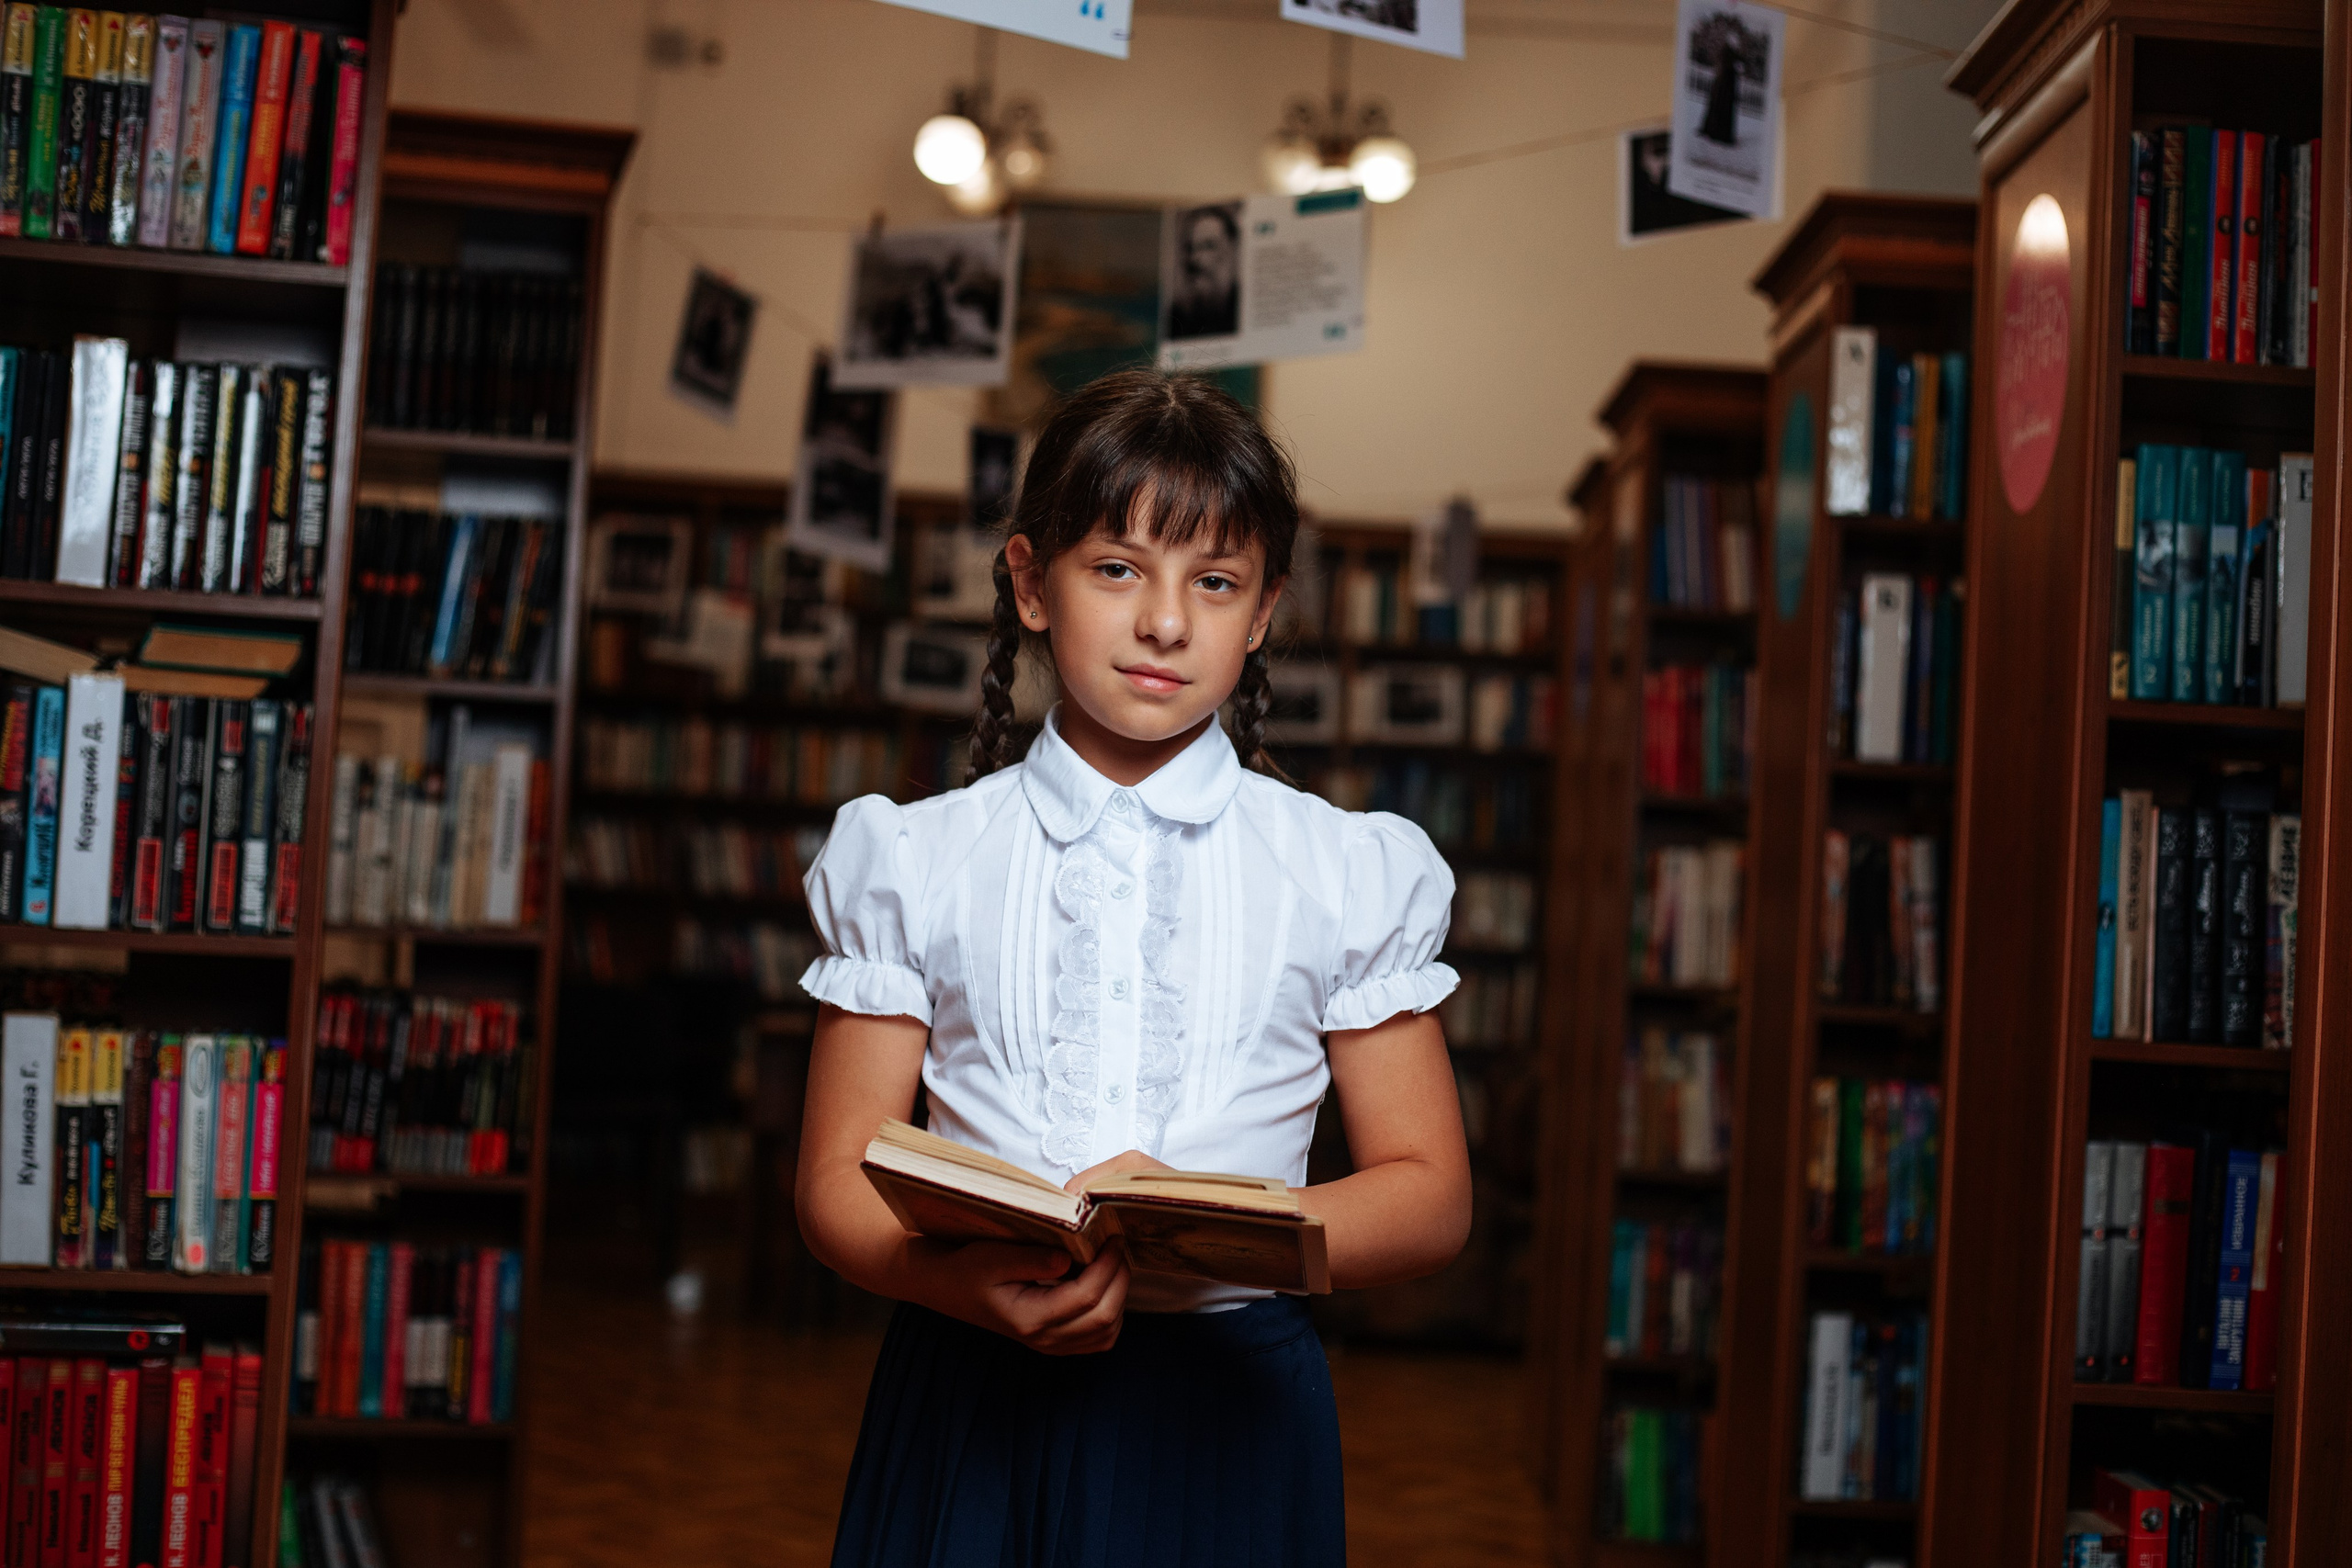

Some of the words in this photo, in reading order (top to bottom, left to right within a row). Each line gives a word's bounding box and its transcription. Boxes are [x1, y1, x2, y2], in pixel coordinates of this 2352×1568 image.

[82, 716, 105, 743] Д.
[74, 745, 99, 852] Корецкий
[20, 1060, 39, 1078] Г.
[17, 1083, 40, 1186] Куликова
[2231, 1175, 2248, 1251] ИЗБРАННОЕ
[171, 1378, 196, 1487] БЕСПРЕДЕЛ
[104, 1493, 124, 1550] ЛЕОНОВ
[168, 1493, 189, 1550] ЛЕОНОВ
